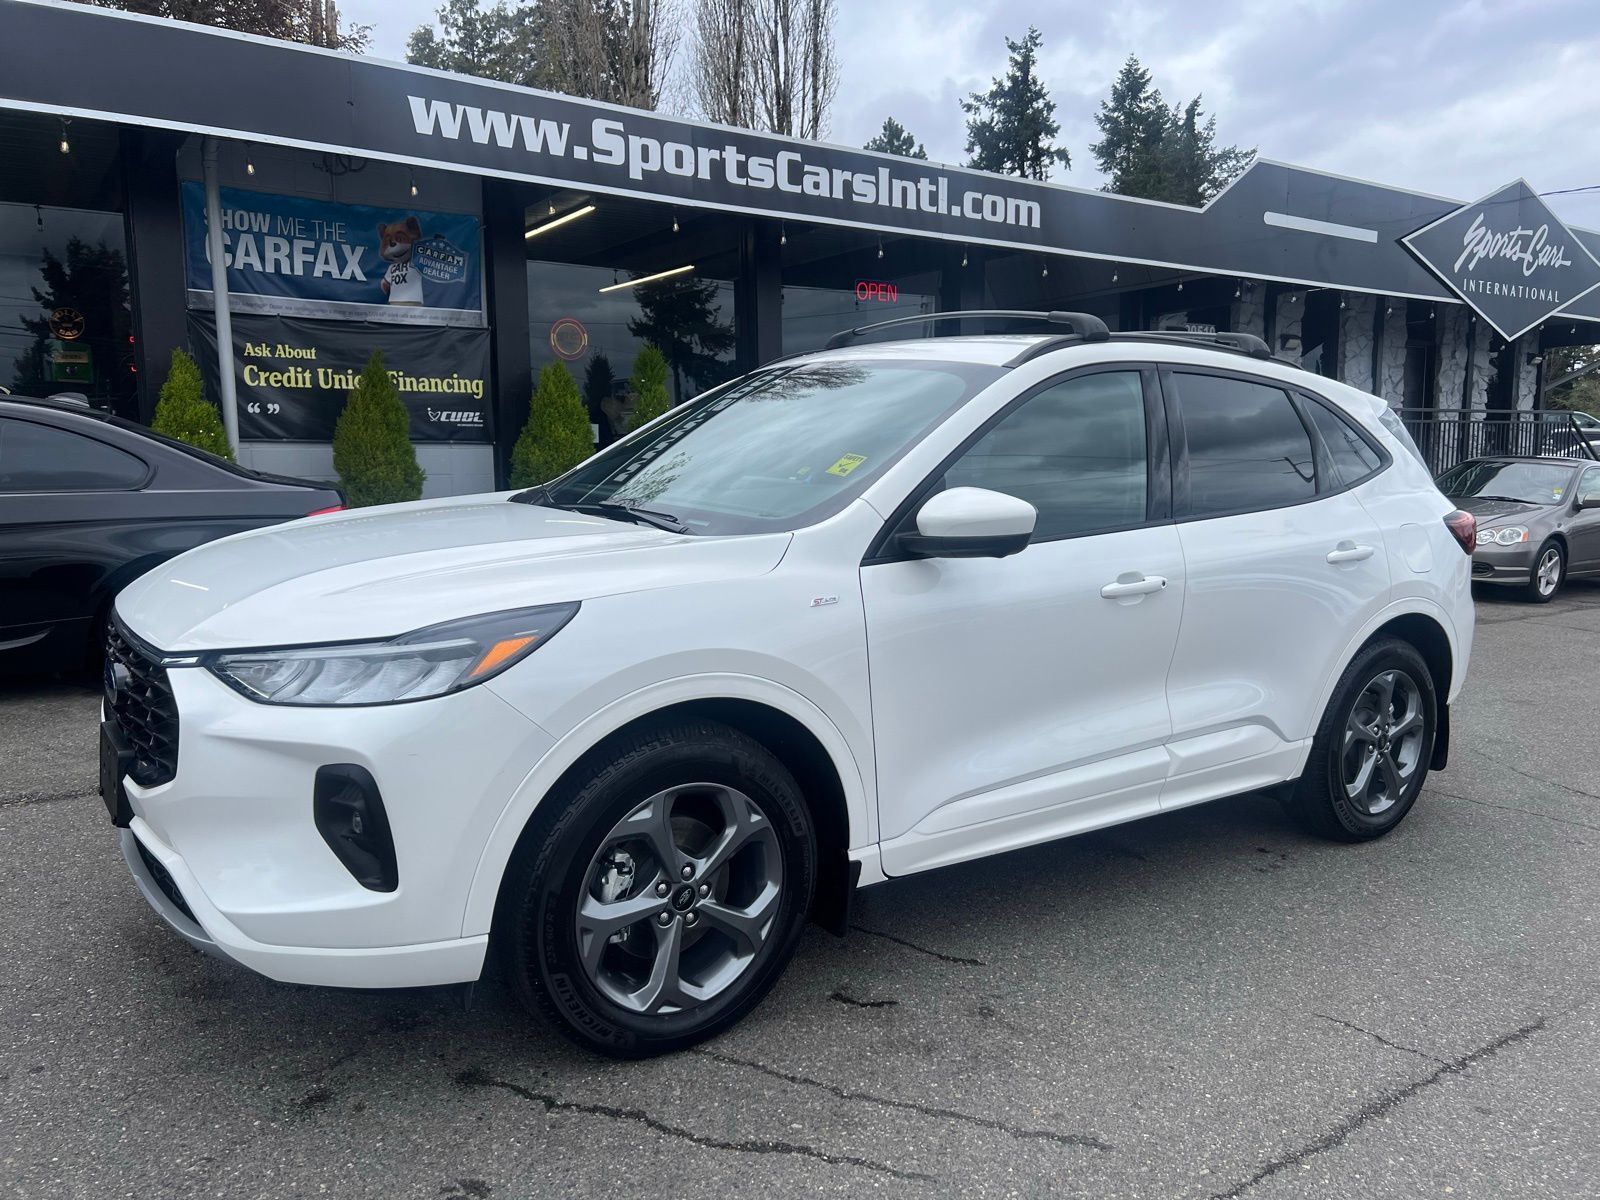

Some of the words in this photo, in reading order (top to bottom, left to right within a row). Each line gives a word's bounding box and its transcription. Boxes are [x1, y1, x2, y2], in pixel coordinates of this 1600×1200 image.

[406, 95, 1041, 229] www.SportsCarsIntl.com
[203, 207, 271, 234] HOW
[277, 215, 306, 238] ME
[312, 220, 347, 243] THE
[1454, 212, 1533, 273] Sports
[1523, 224, 1571, 277] Cars
[417, 245, 464, 266] CARFAX
[419, 257, 458, 274] ADVANTAGE
[391, 262, 409, 275] CAR
[391, 273, 408, 285] FOX
[423, 266, 450, 280] DEALER
[856, 282, 897, 302] OPEN
[1463, 278, 1560, 303] INTERNATIONAL
[244, 343, 272, 358] Ask
[275, 344, 317, 360] About
[244, 365, 313, 389] Credit
[317, 368, 363, 390] Unio
[555, 977, 613, 1038] MICHELIN
